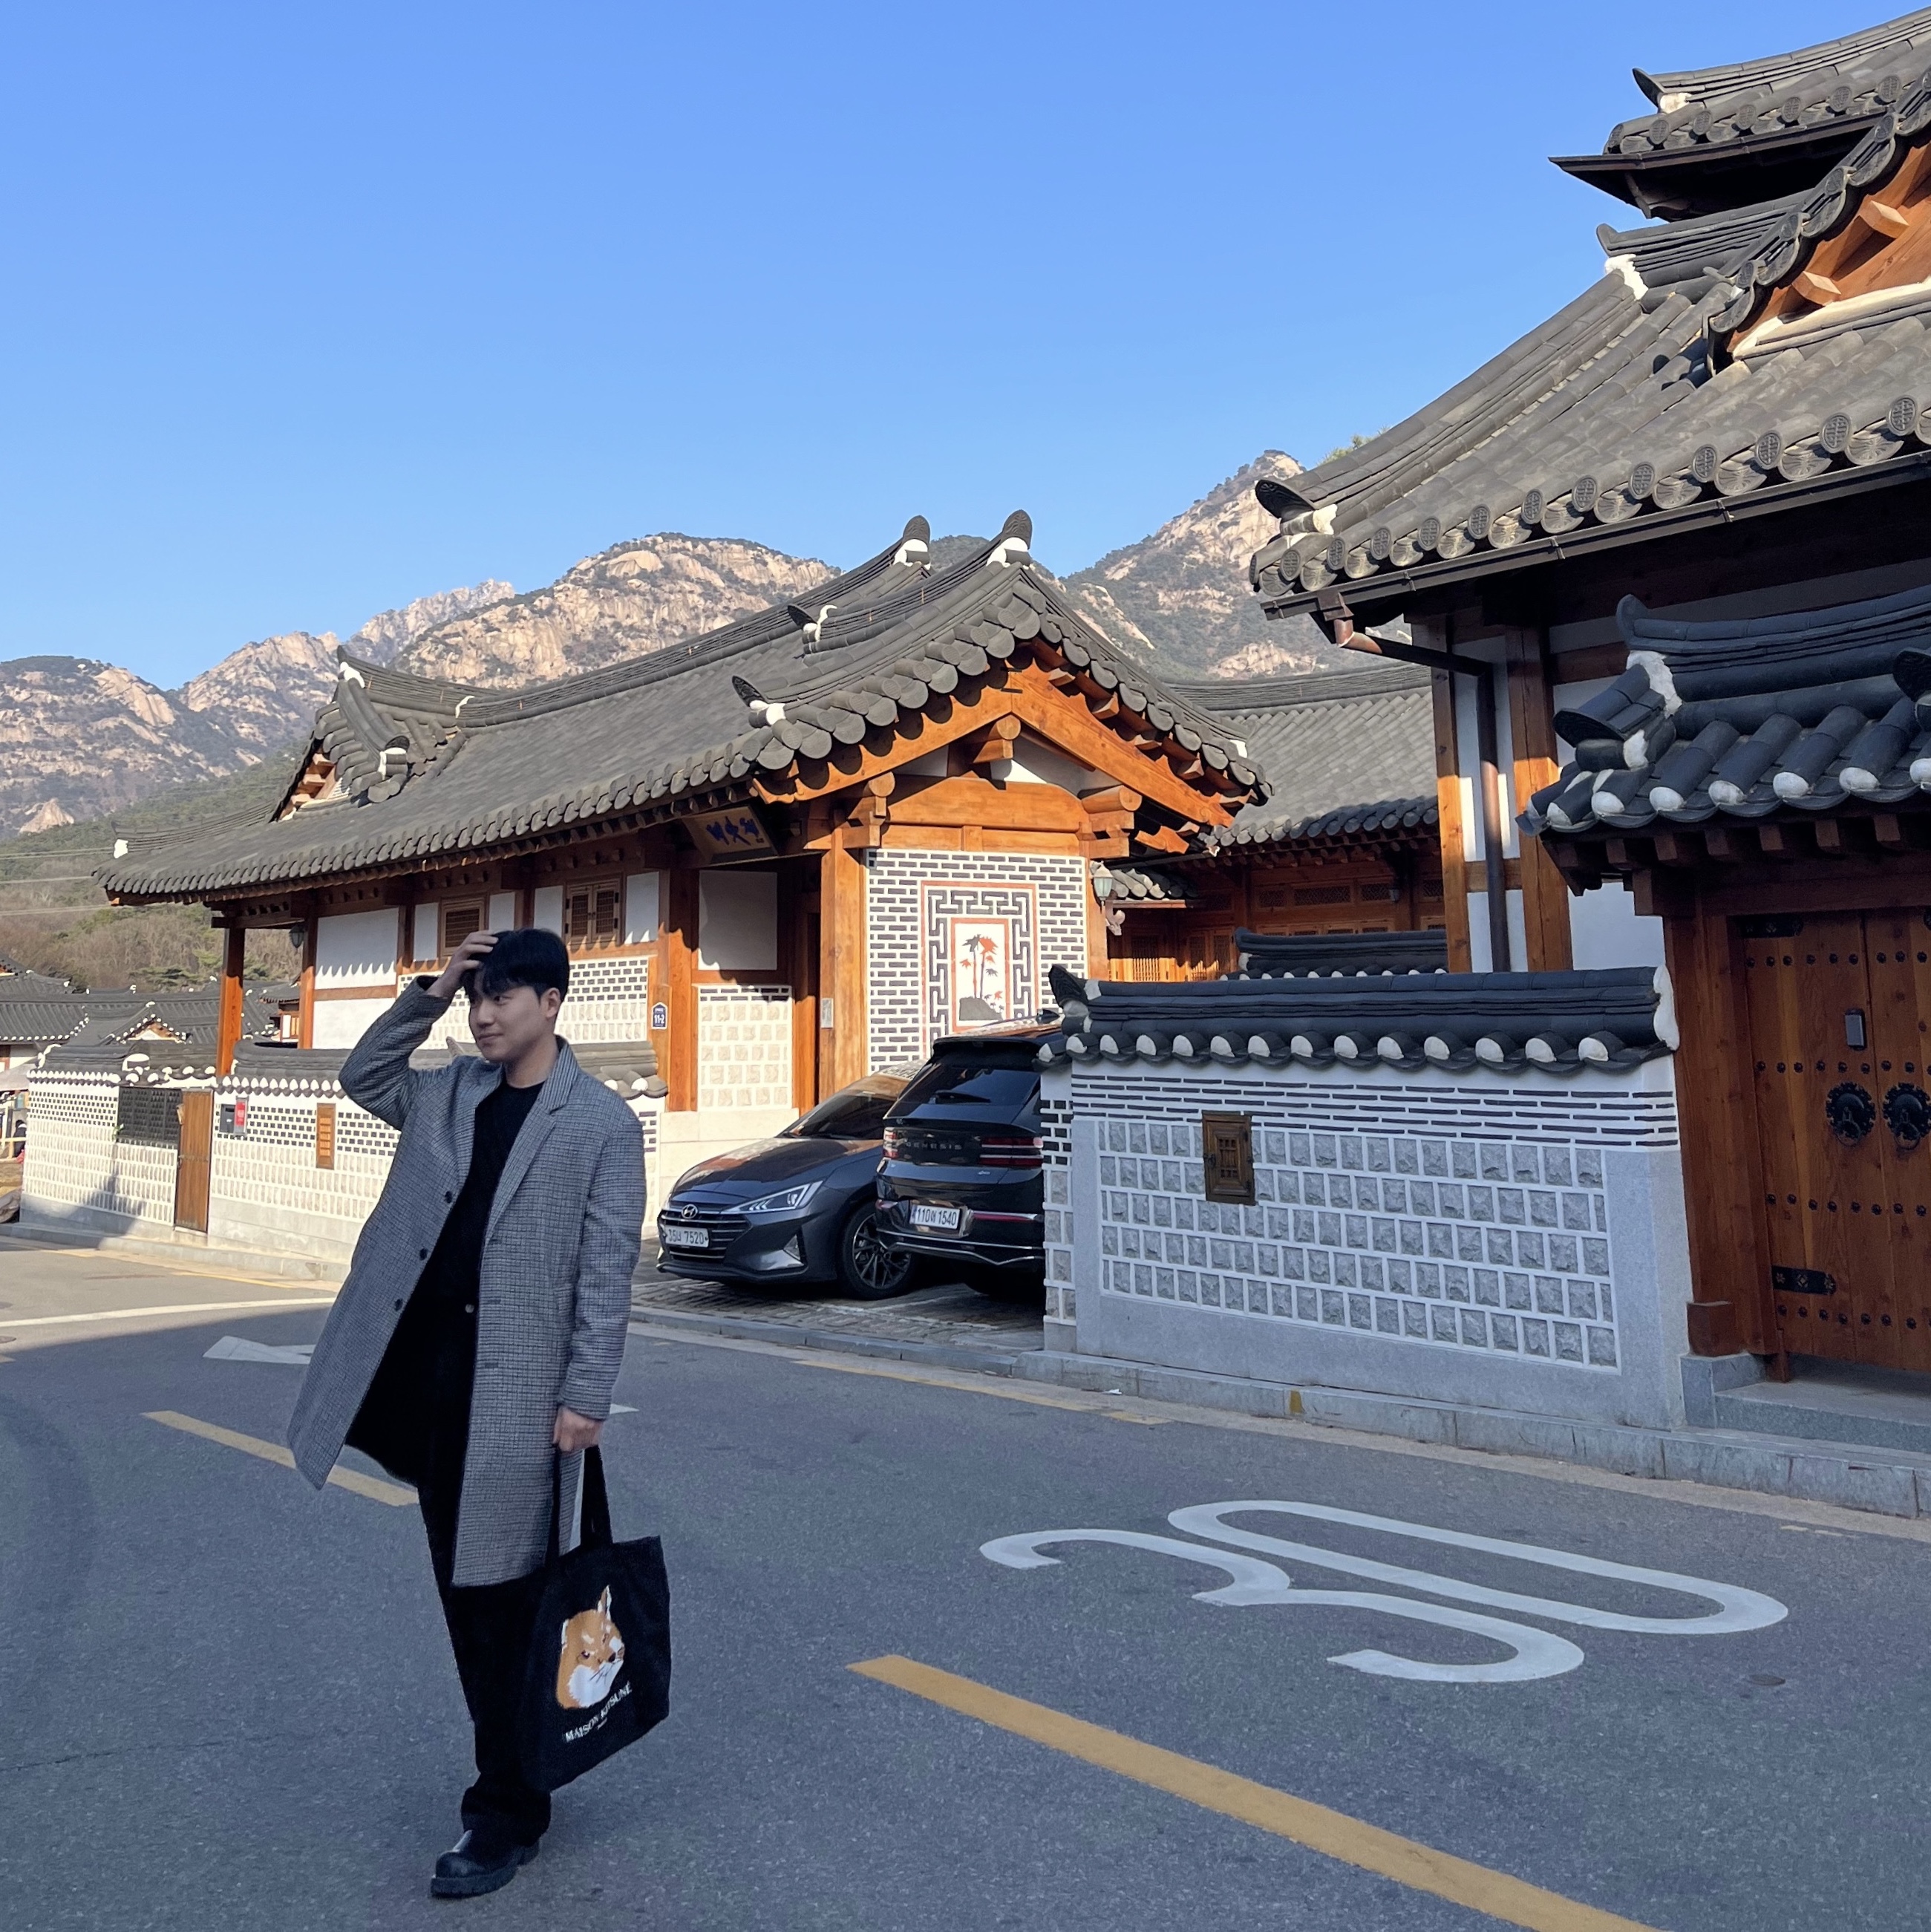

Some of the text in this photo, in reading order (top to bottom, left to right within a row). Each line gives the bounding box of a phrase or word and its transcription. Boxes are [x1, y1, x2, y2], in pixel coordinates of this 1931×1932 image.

[654, 1014, 665, 1024] 11-2
[906, 1141, 962, 1150] GENESIS
[938, 1210, 957, 1226] 1540
[684, 1230, 705, 1244] 7520
[980, 1500, 1788, 1683] 30
[565, 1714, 600, 1743] MAISON
